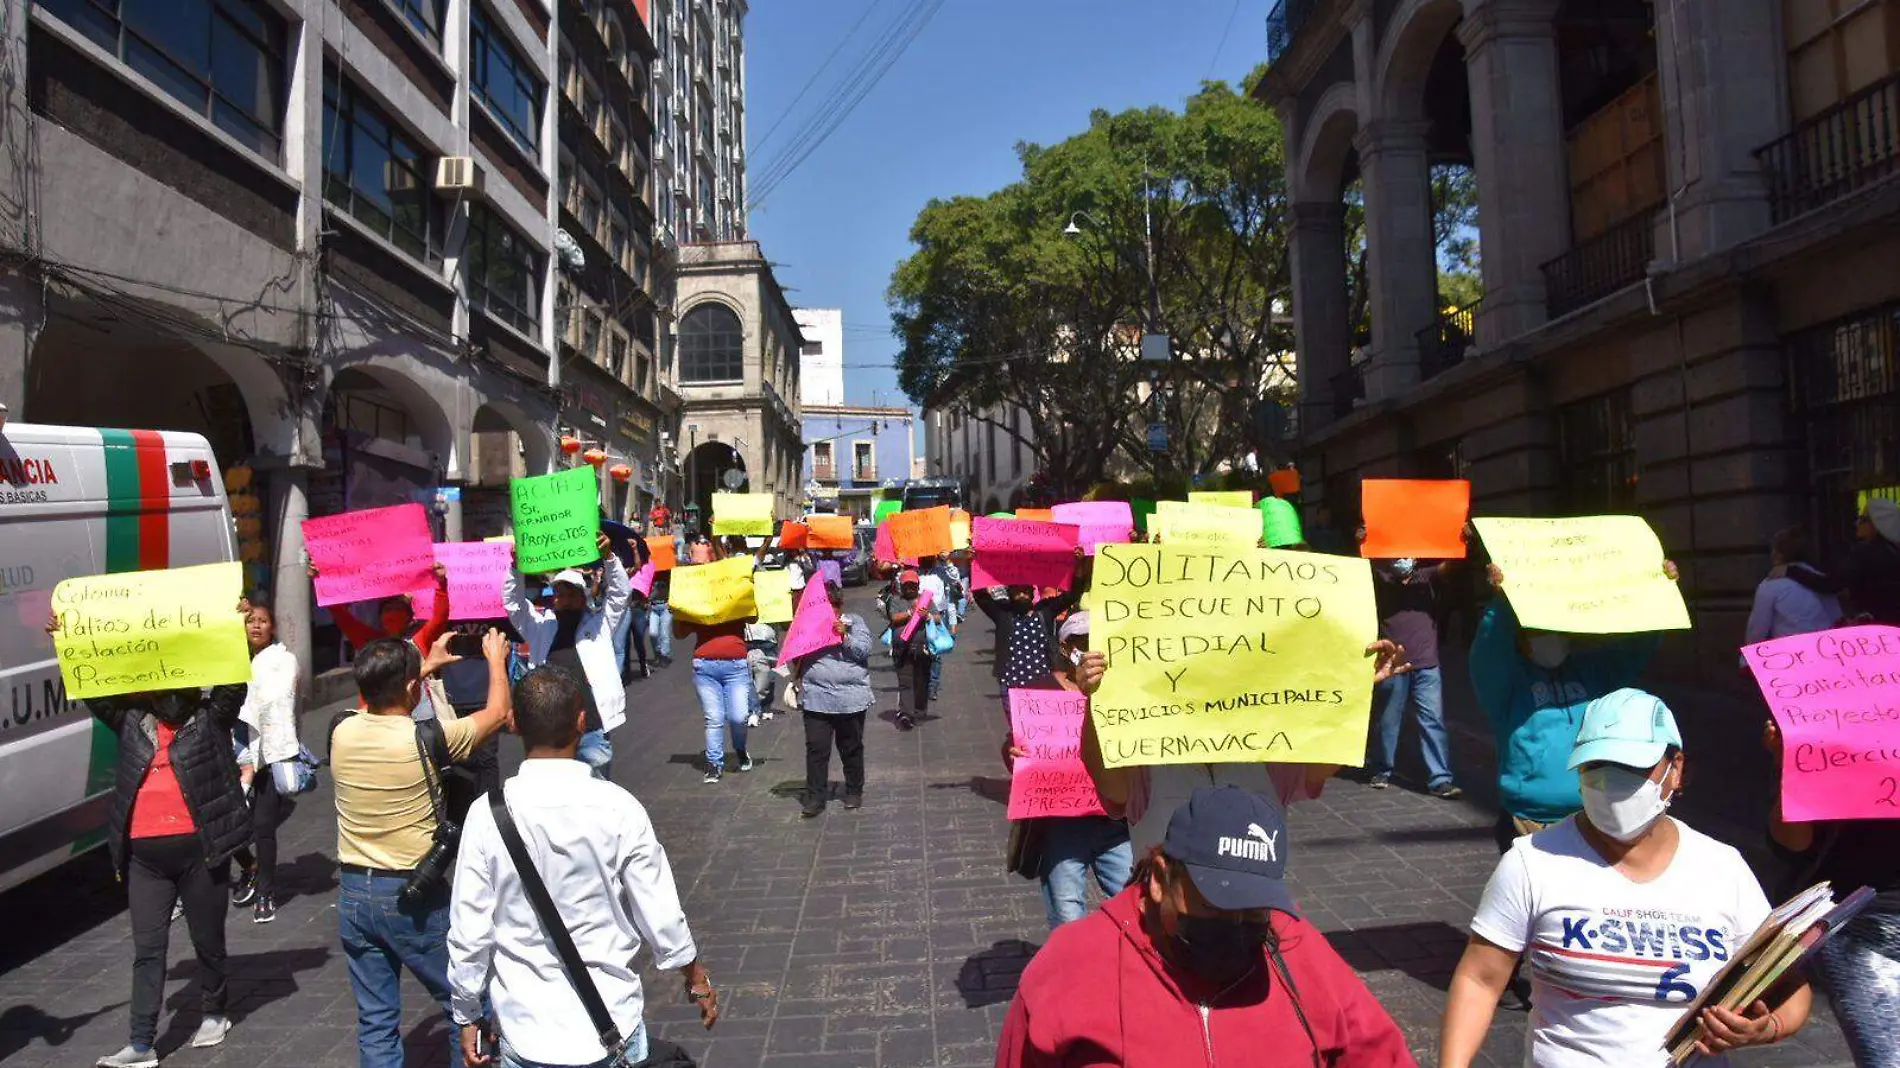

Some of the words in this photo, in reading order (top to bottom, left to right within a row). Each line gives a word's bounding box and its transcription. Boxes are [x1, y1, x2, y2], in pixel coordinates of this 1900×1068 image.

[521, 525, 588, 548] PROYECTOS
[1100, 545, 1339, 587] SOLITAMOS
[60, 608, 131, 639] Patios
[144, 608, 168, 630] de
[180, 605, 201, 629] la
[1105, 595, 1321, 622] DESCUENTO
[64, 639, 160, 661] estación
[1107, 632, 1277, 668] PREDIAL
[1817, 633, 1900, 667] GOBE
[1165, 668, 1188, 692] Y
[1094, 703, 1195, 728] SERVICIOS
[1205, 689, 1343, 713] MUNICIPALES
[1103, 732, 1292, 763] CUERNAVACA
[1875, 776, 1898, 806] 2
[1218, 836, 1268, 861] PUMA
[1602, 907, 1633, 918] CALIF
[1635, 909, 1668, 920] SHOE
[1670, 913, 1702, 924] TEAM
